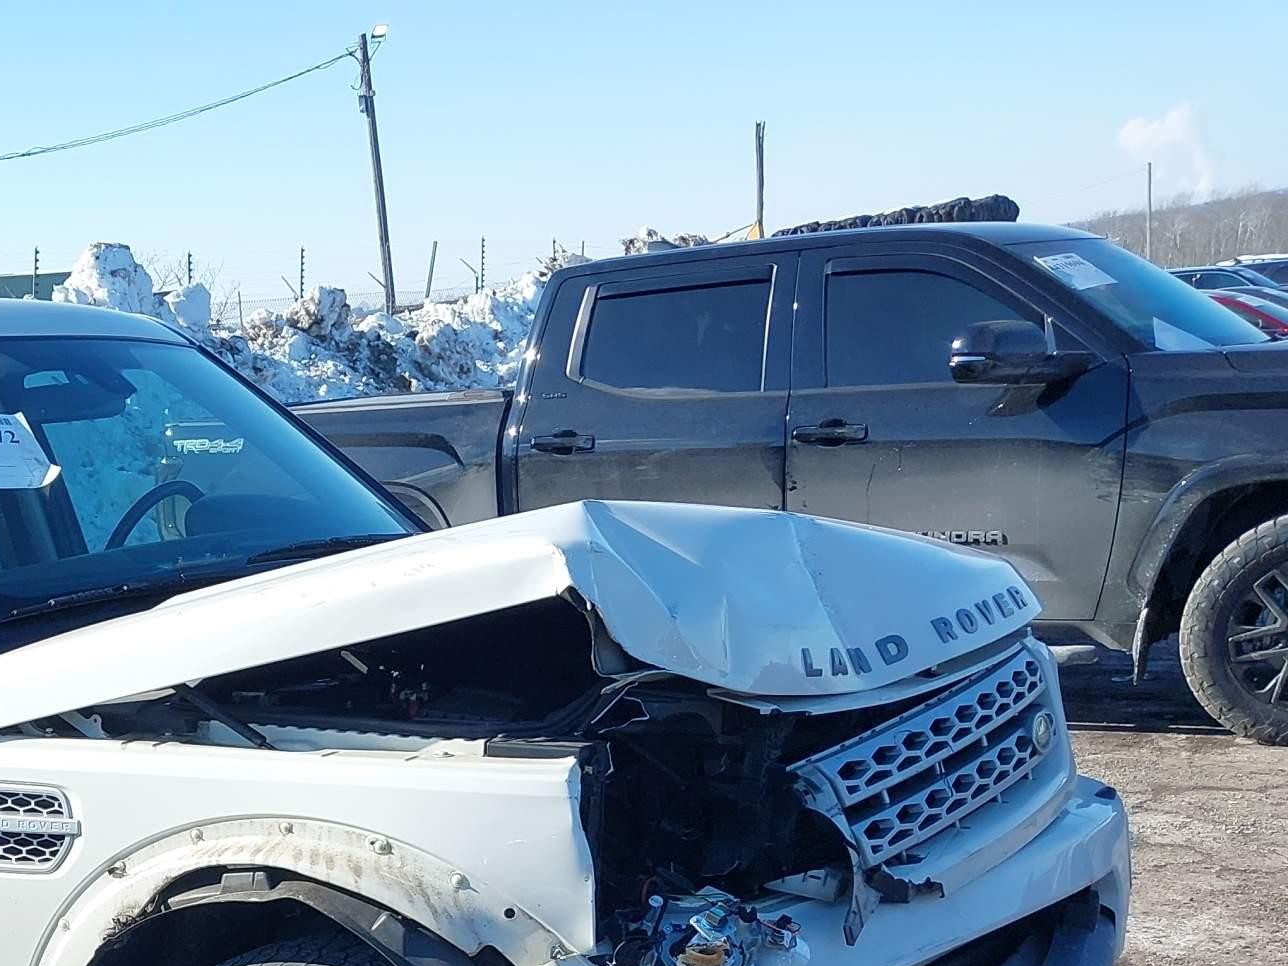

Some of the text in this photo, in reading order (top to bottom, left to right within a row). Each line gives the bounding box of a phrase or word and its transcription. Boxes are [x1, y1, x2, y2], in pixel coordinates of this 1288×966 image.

[800, 585, 1028, 678] LAND ROVER
[17, 820, 72, 832] ROVER
